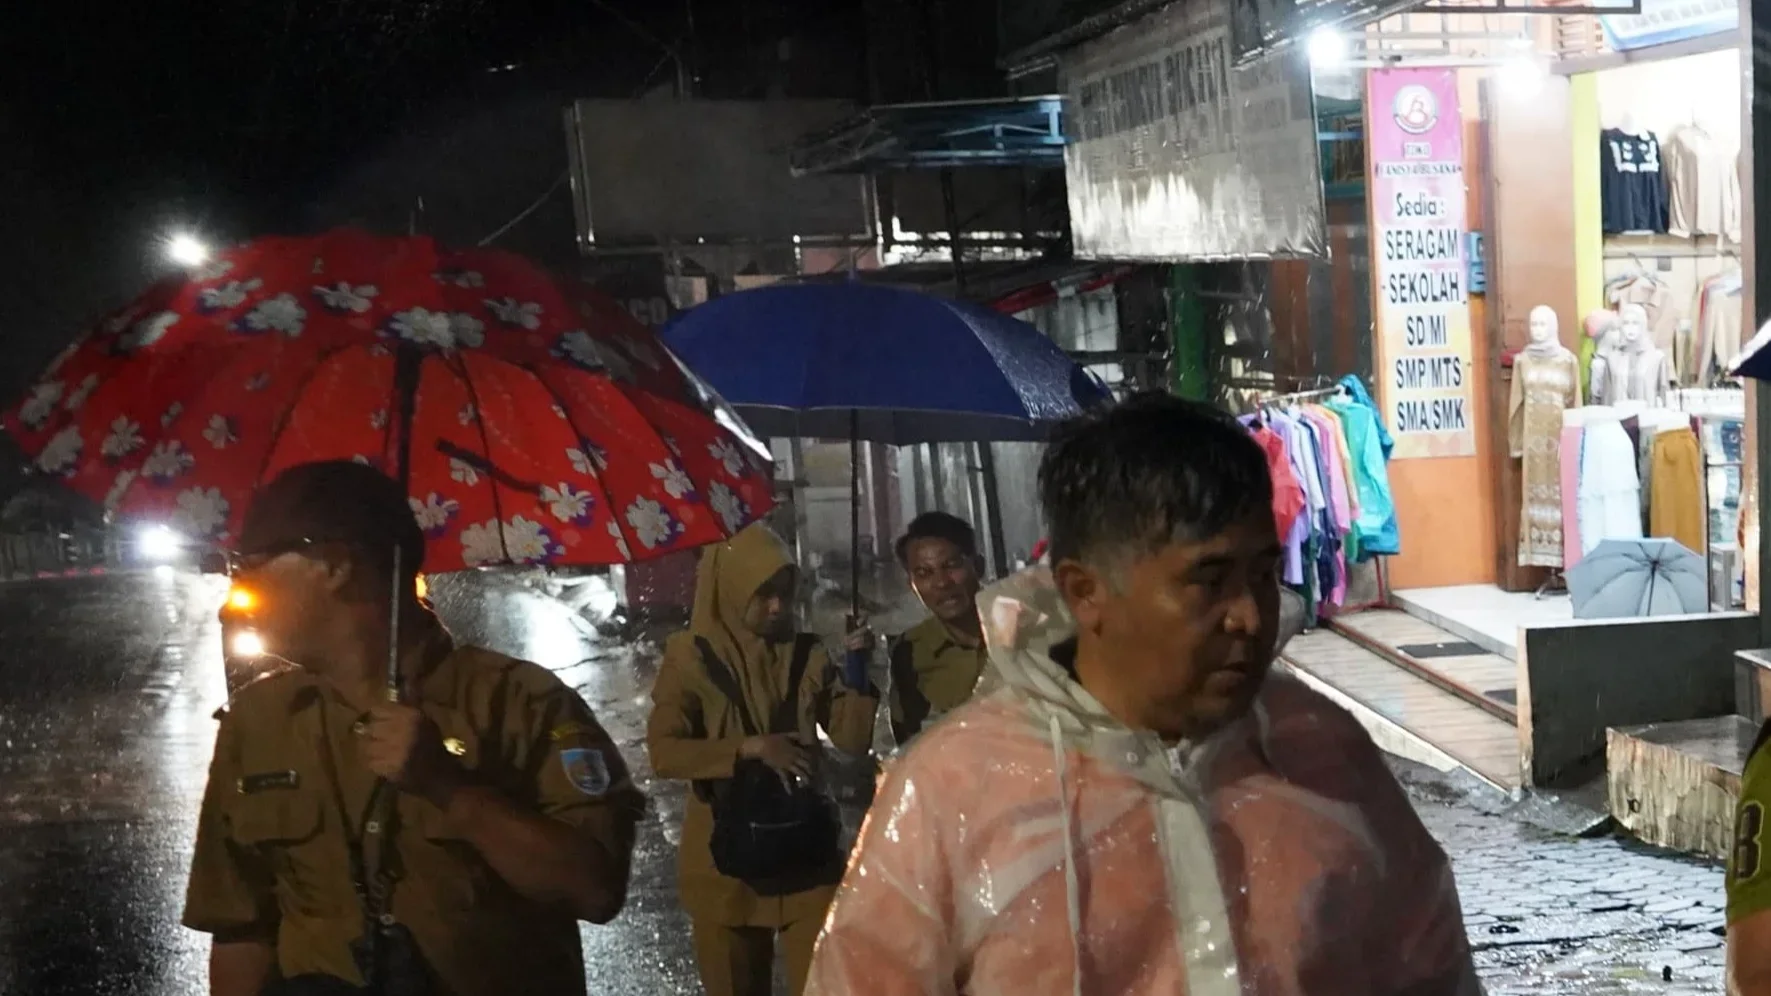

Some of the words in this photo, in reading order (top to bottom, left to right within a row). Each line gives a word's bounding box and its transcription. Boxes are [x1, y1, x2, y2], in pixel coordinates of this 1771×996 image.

[1396, 192, 1437, 217] Sedia
[1386, 228, 1459, 260] SERAGAM
[1389, 271, 1460, 304] SEKOLAH
